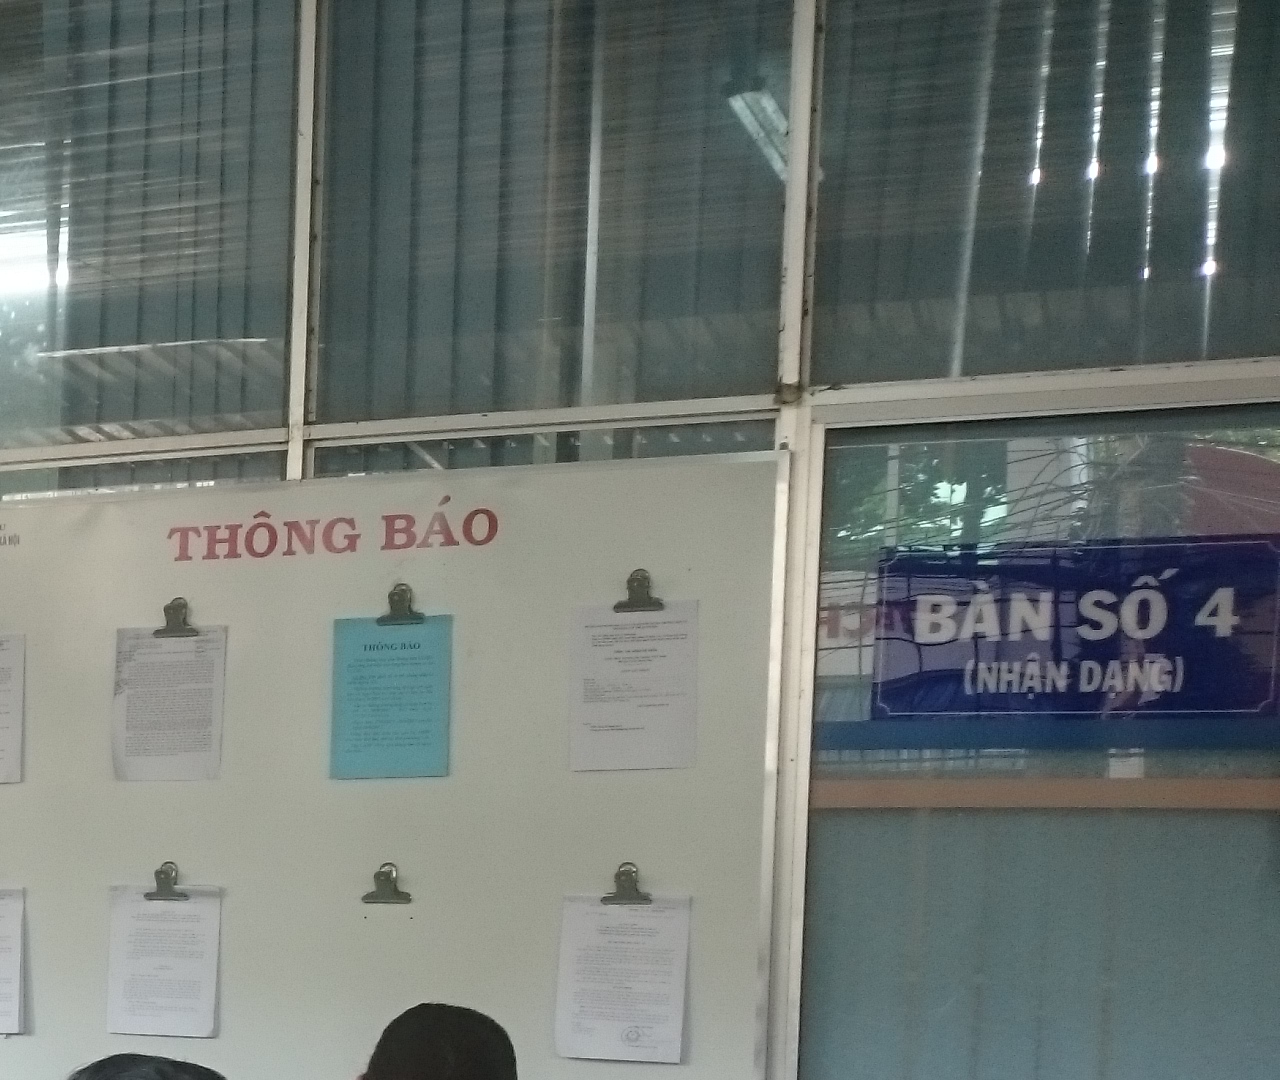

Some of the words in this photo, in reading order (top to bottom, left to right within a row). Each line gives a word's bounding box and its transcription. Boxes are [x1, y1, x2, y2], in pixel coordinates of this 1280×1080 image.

[167, 511, 362, 562] THÔNG
[380, 495, 499, 551] BÁO
[913, 580, 1055, 644] BÀN
[1077, 568, 1180, 641] SỐ
[1194, 587, 1240, 638] 4
[362, 641, 398, 652] THÔNG
[964, 652, 1070, 699] (NHẬN
[1079, 656, 1184, 699] DẠNG)
